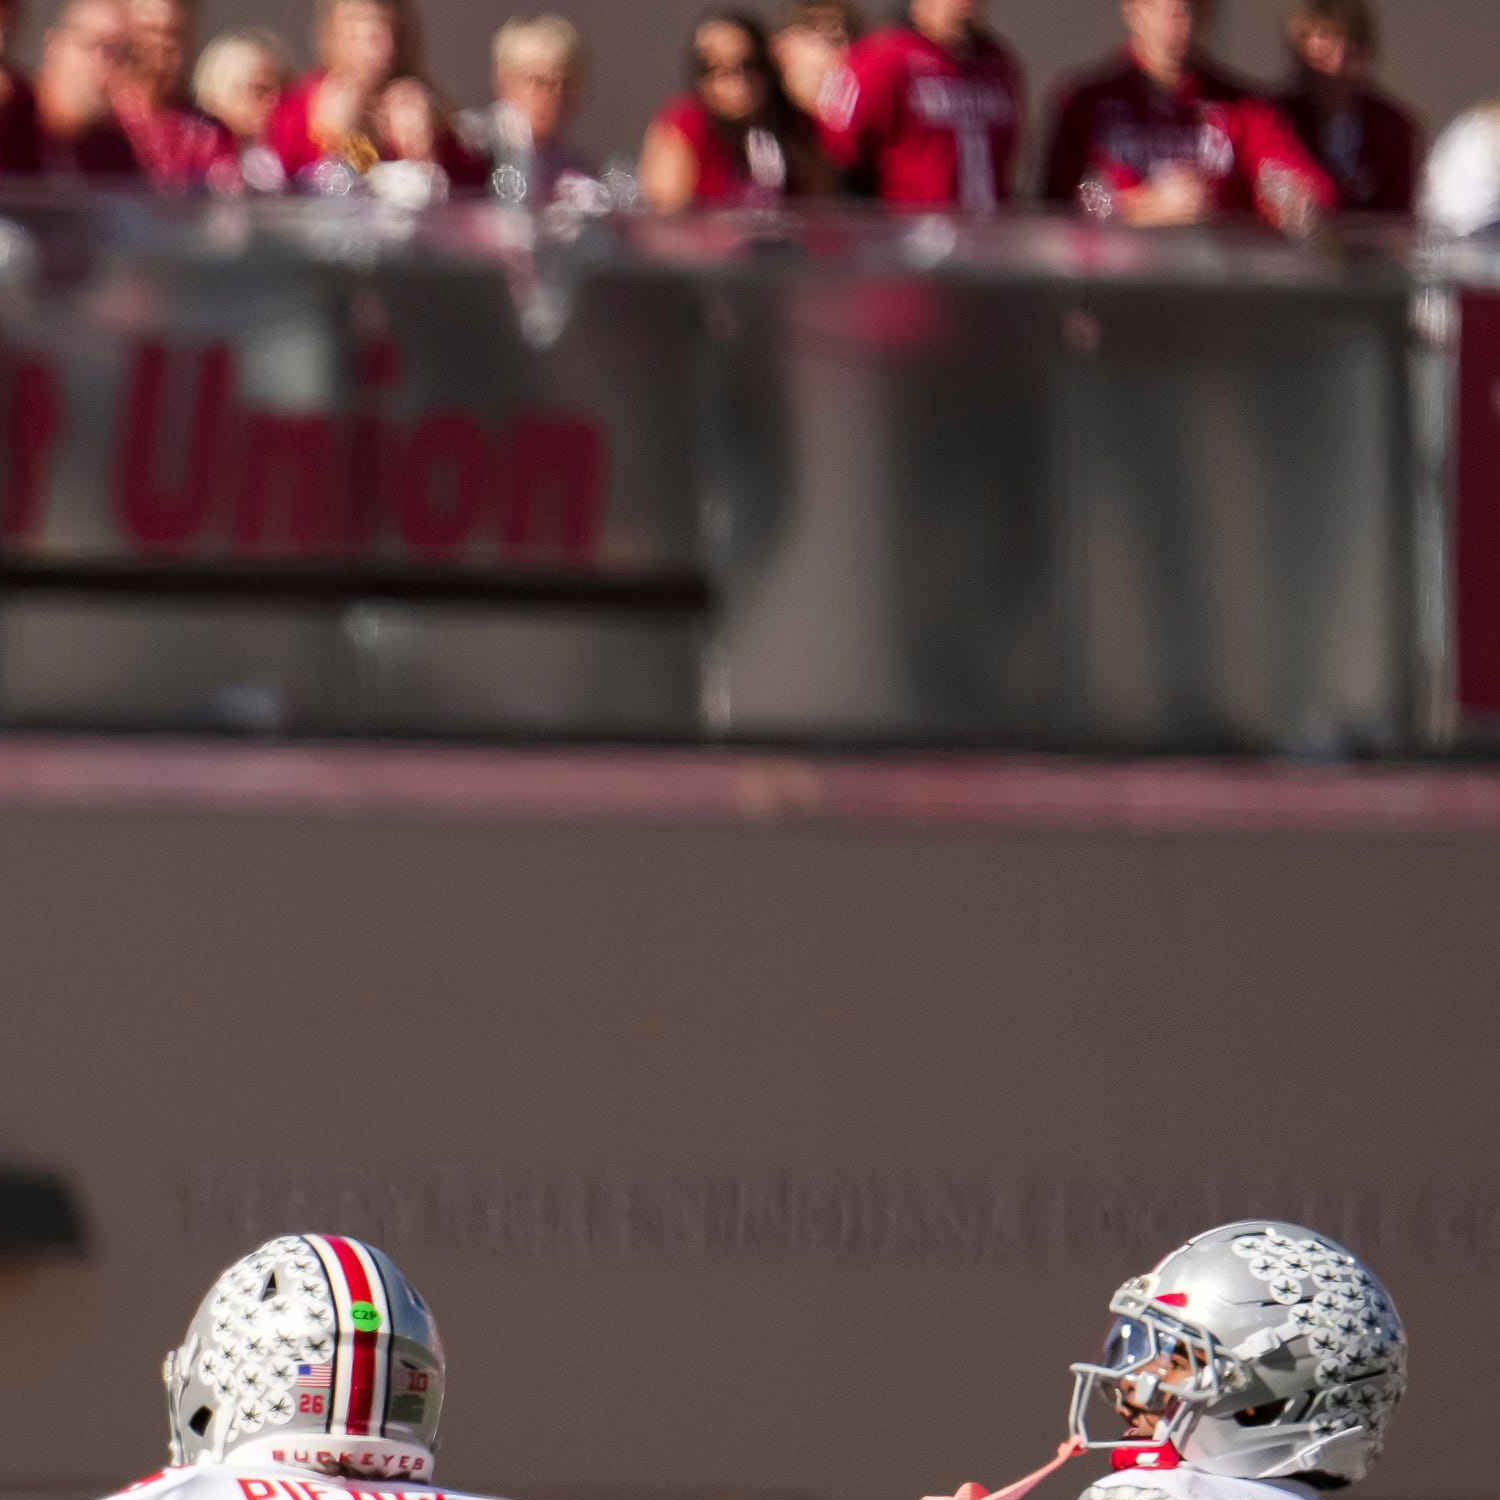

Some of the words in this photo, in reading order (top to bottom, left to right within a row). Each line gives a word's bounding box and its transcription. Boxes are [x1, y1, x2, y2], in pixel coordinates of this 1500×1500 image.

[115, 335, 606, 561] Union
[299, 1393, 326, 1415] 26
[272, 1448, 426, 1471] BUCKEYES
